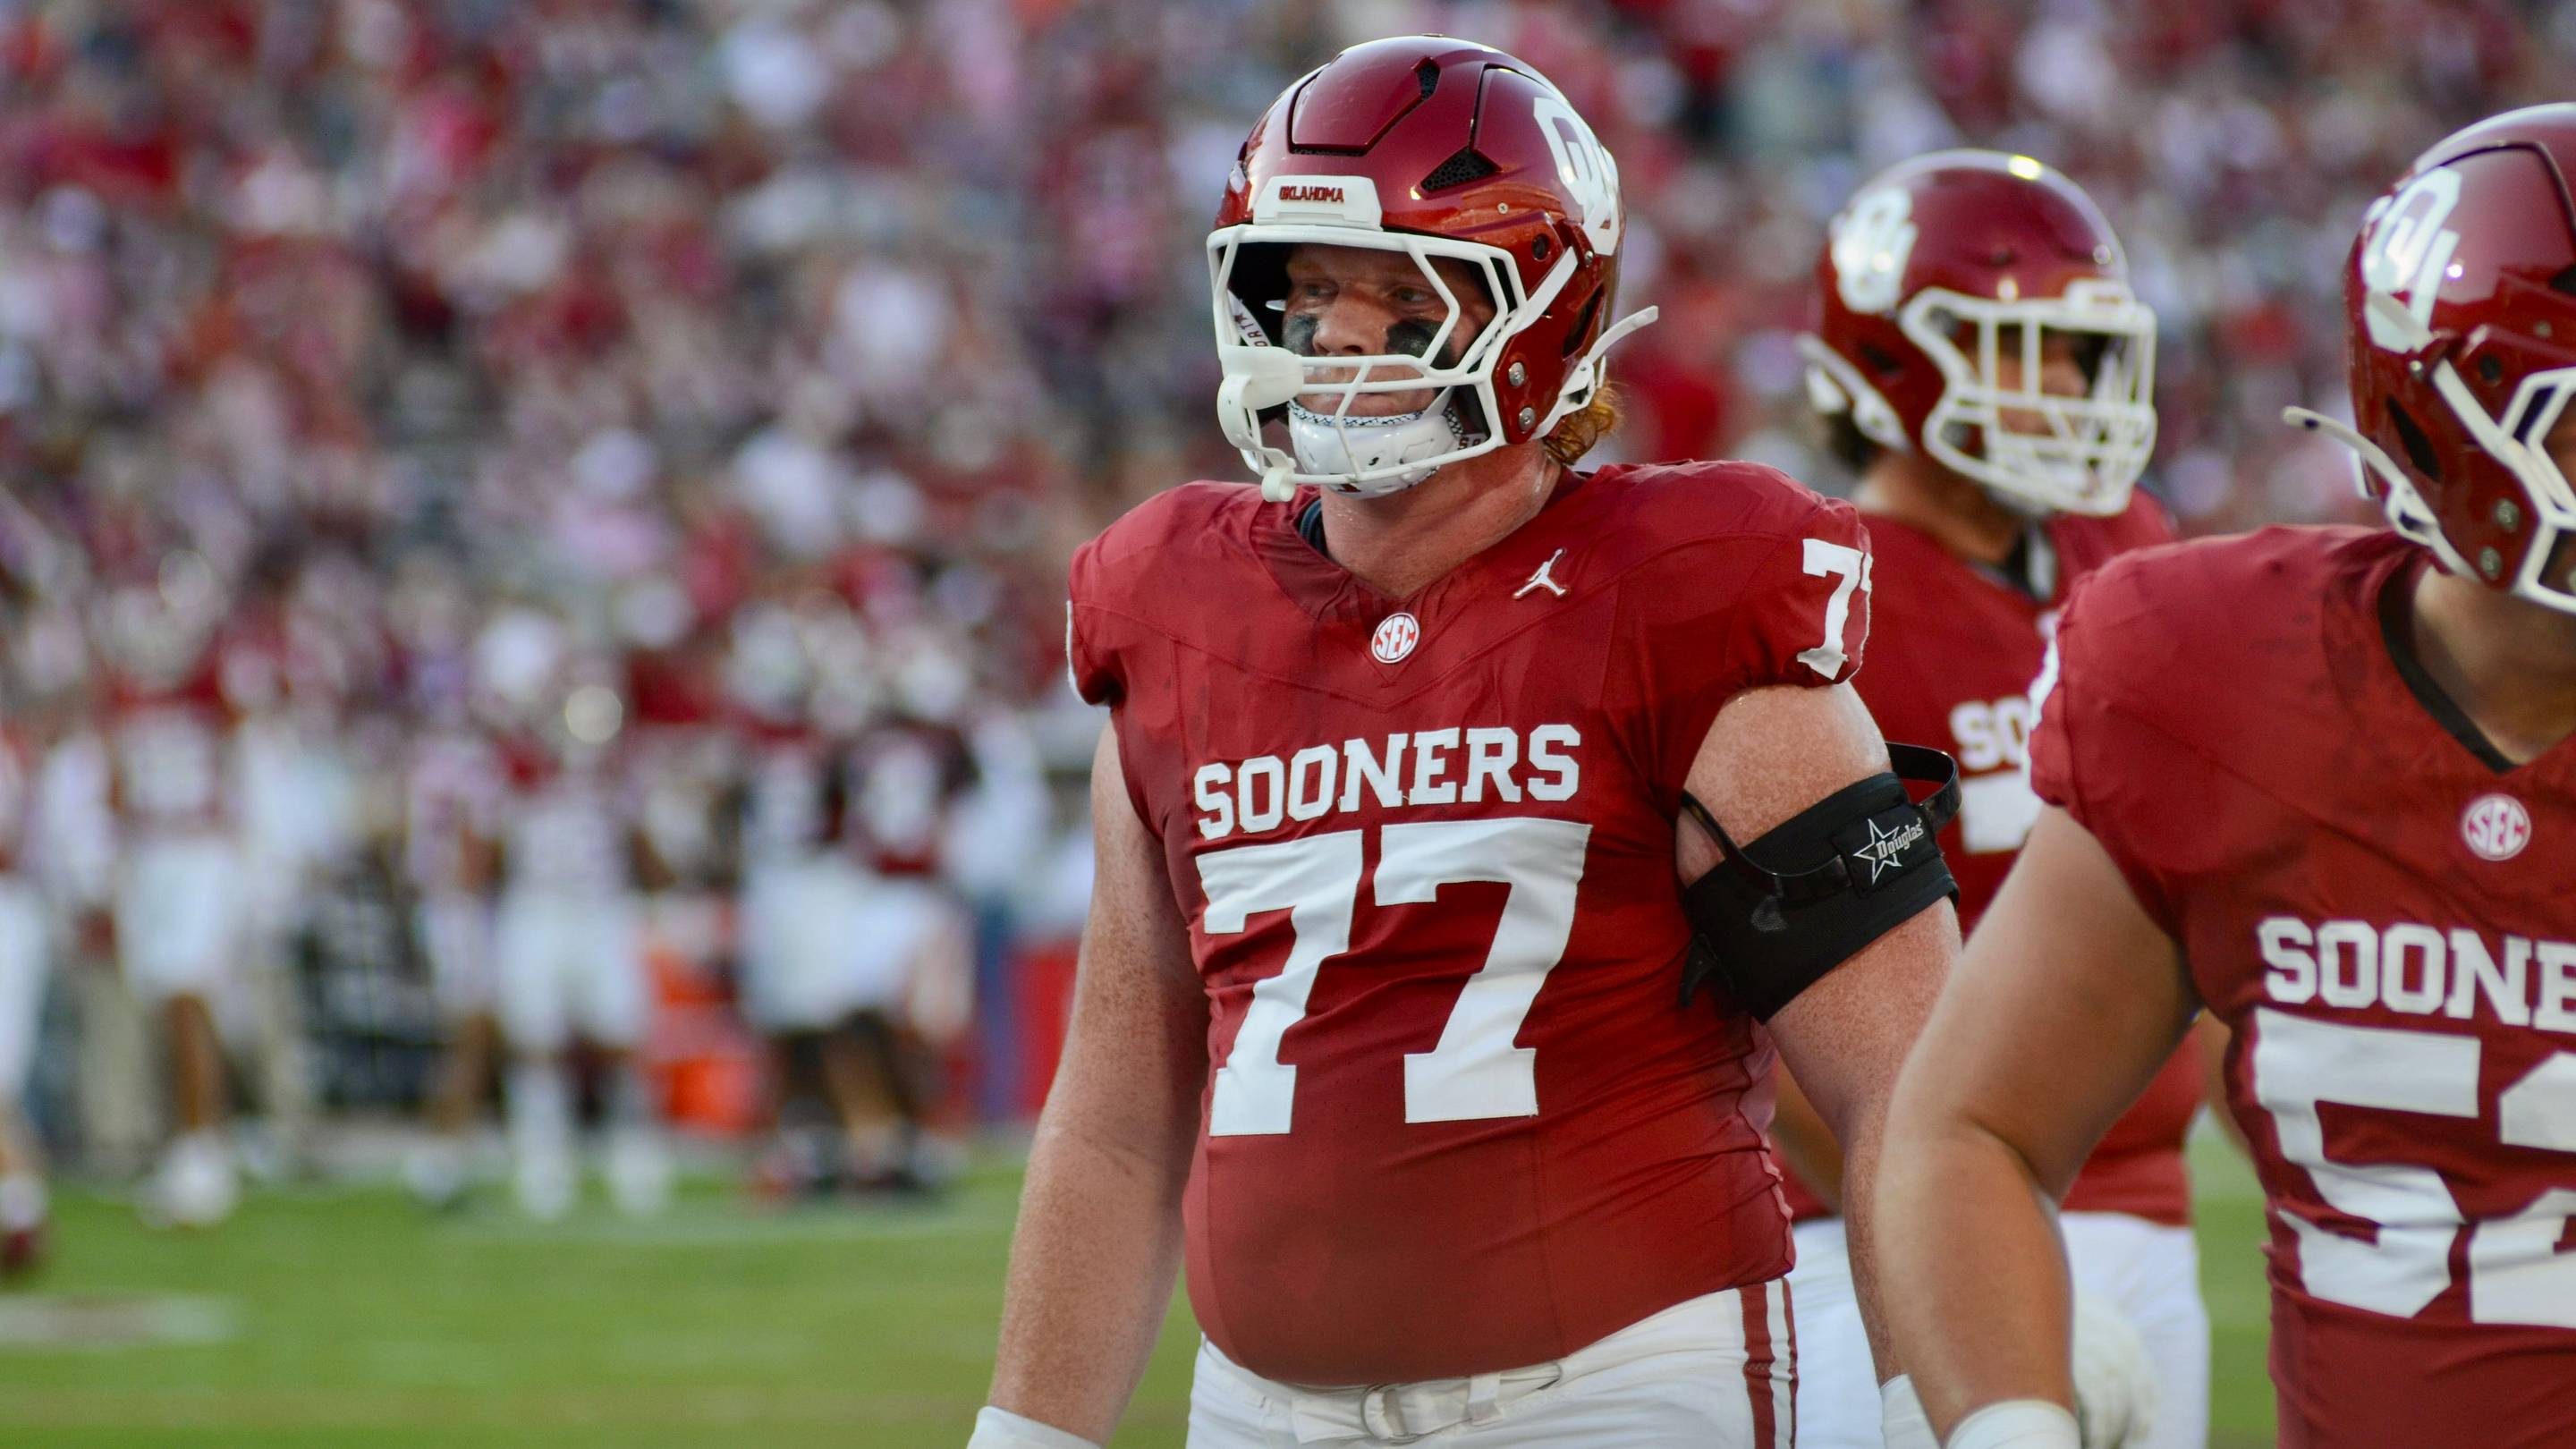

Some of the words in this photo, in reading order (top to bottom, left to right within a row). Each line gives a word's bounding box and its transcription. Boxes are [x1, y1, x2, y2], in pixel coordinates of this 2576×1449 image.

[1279, 185, 1344, 202] OKLAHOMA
[1375, 615, 1416, 659] SEC
[1797, 538, 1873, 680] 7
[1194, 724, 1580, 840] SOONERS
[1876, 823, 1924, 860] Douglas
[2466, 800, 2526, 856] SEC
[1196, 817, 1593, 1136] 77
